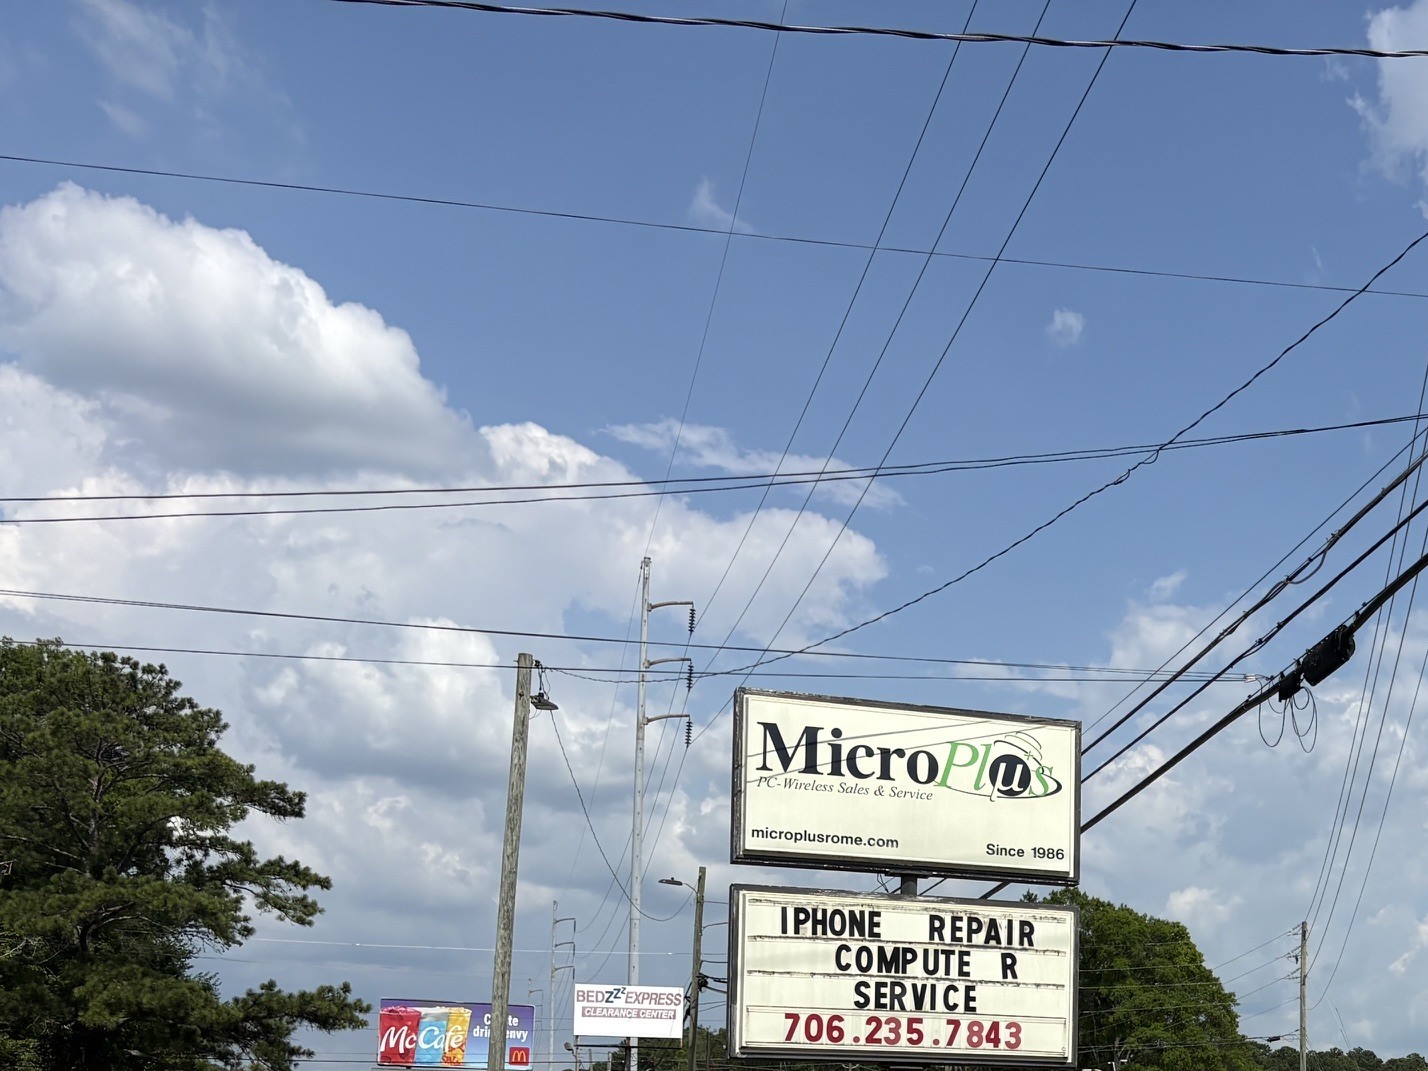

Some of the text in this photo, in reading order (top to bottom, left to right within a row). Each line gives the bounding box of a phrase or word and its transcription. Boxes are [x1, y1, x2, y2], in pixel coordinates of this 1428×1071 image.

[757, 776, 933, 801] PC-Wireless Sales & Service
[751, 827, 899, 849] microplusrome.com
[986, 843, 1065, 860] Since 1986
[781, 906, 1035, 947] IPHONE REPAIR
[835, 944, 1018, 980] COMPUTE R
[625, 991, 682, 1007] EXPRESS
[854, 980, 977, 1012] SERVICE
[483, 1013, 519, 1027] Cte
[584, 1007, 675, 1019] CLEARANCE CENTER
[784, 1012, 1022, 1050] 706.235.7843
